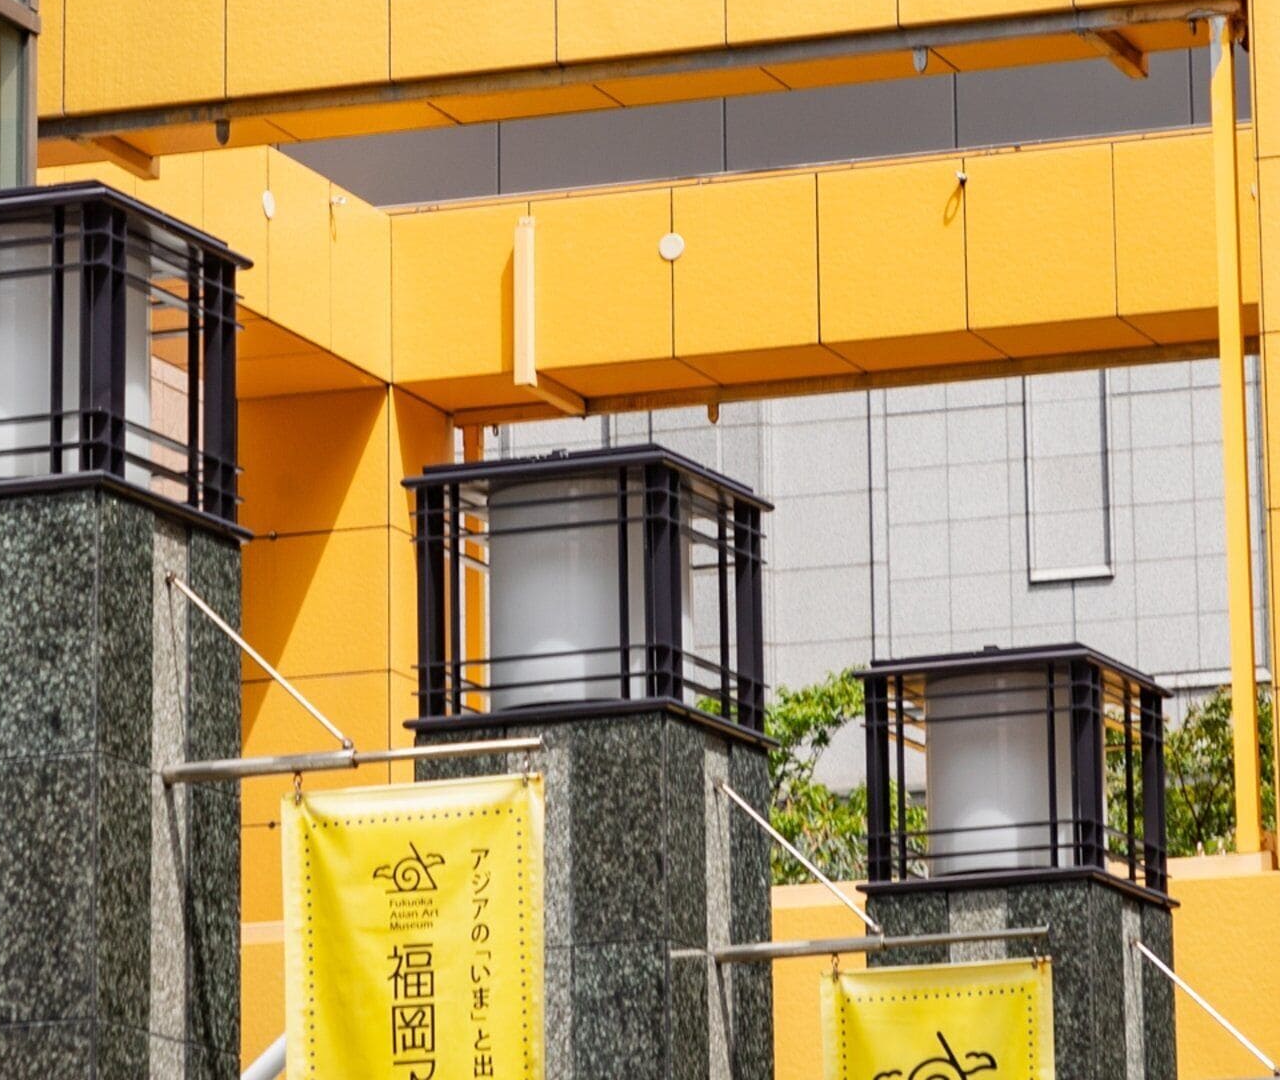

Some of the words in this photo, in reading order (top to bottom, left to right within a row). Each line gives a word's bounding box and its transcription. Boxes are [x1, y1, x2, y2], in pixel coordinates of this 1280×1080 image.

[389, 897, 434, 908] Fukuoka
[390, 909, 419, 919] Asian
[421, 908, 440, 918] Art
[389, 921, 434, 931] Museum
